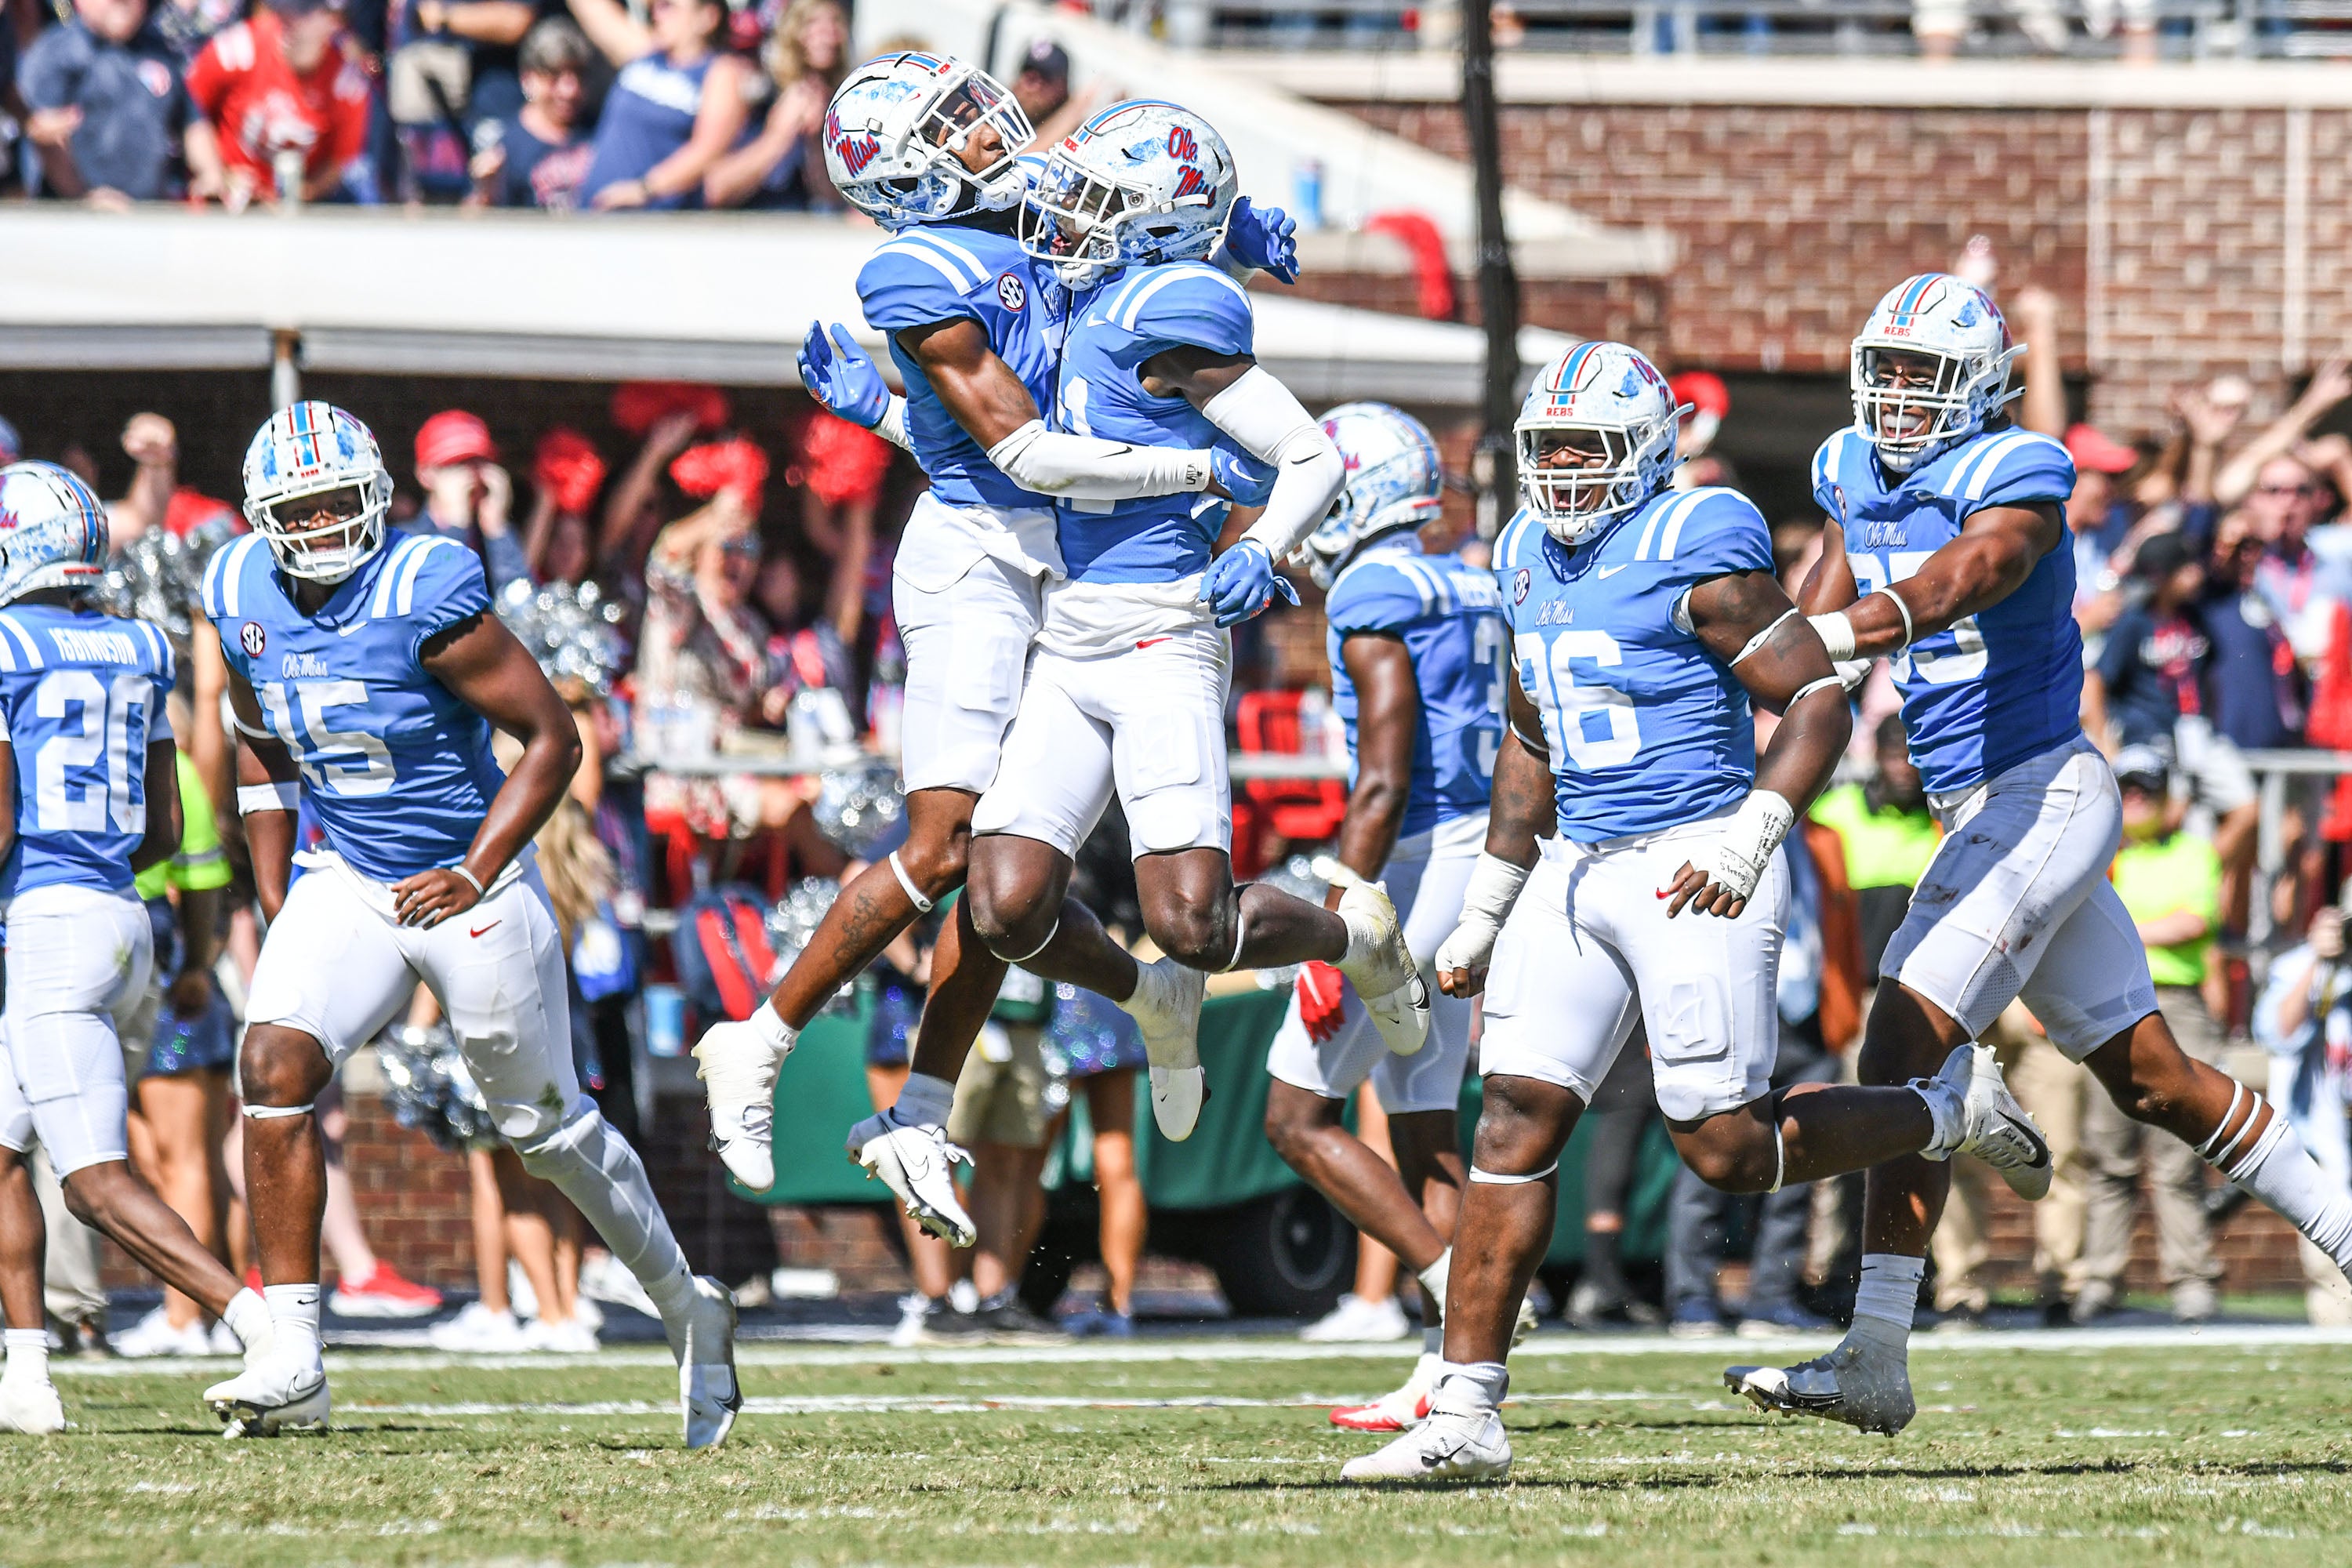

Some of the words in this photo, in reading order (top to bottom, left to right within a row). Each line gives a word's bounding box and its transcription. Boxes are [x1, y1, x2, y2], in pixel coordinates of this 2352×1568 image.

[825, 106, 841, 149] Ole
[1168, 125, 1198, 162] Ole
[837, 132, 880, 179] Miss
[999, 274, 1025, 310] SEC
[1884, 326, 1910, 337] REBS
[1546, 408, 1573, 417] REBS
[1865, 521, 1882, 547] Ole
[1882, 521, 1907, 547] Miss
[1535, 601, 1552, 626] Ole
[1549, 600, 1575, 626] Miss
[241, 623, 264, 655] SEC
[281, 653, 301, 680] Ole
[298, 652, 328, 678] Miss
[36, 670, 154, 833] 20
